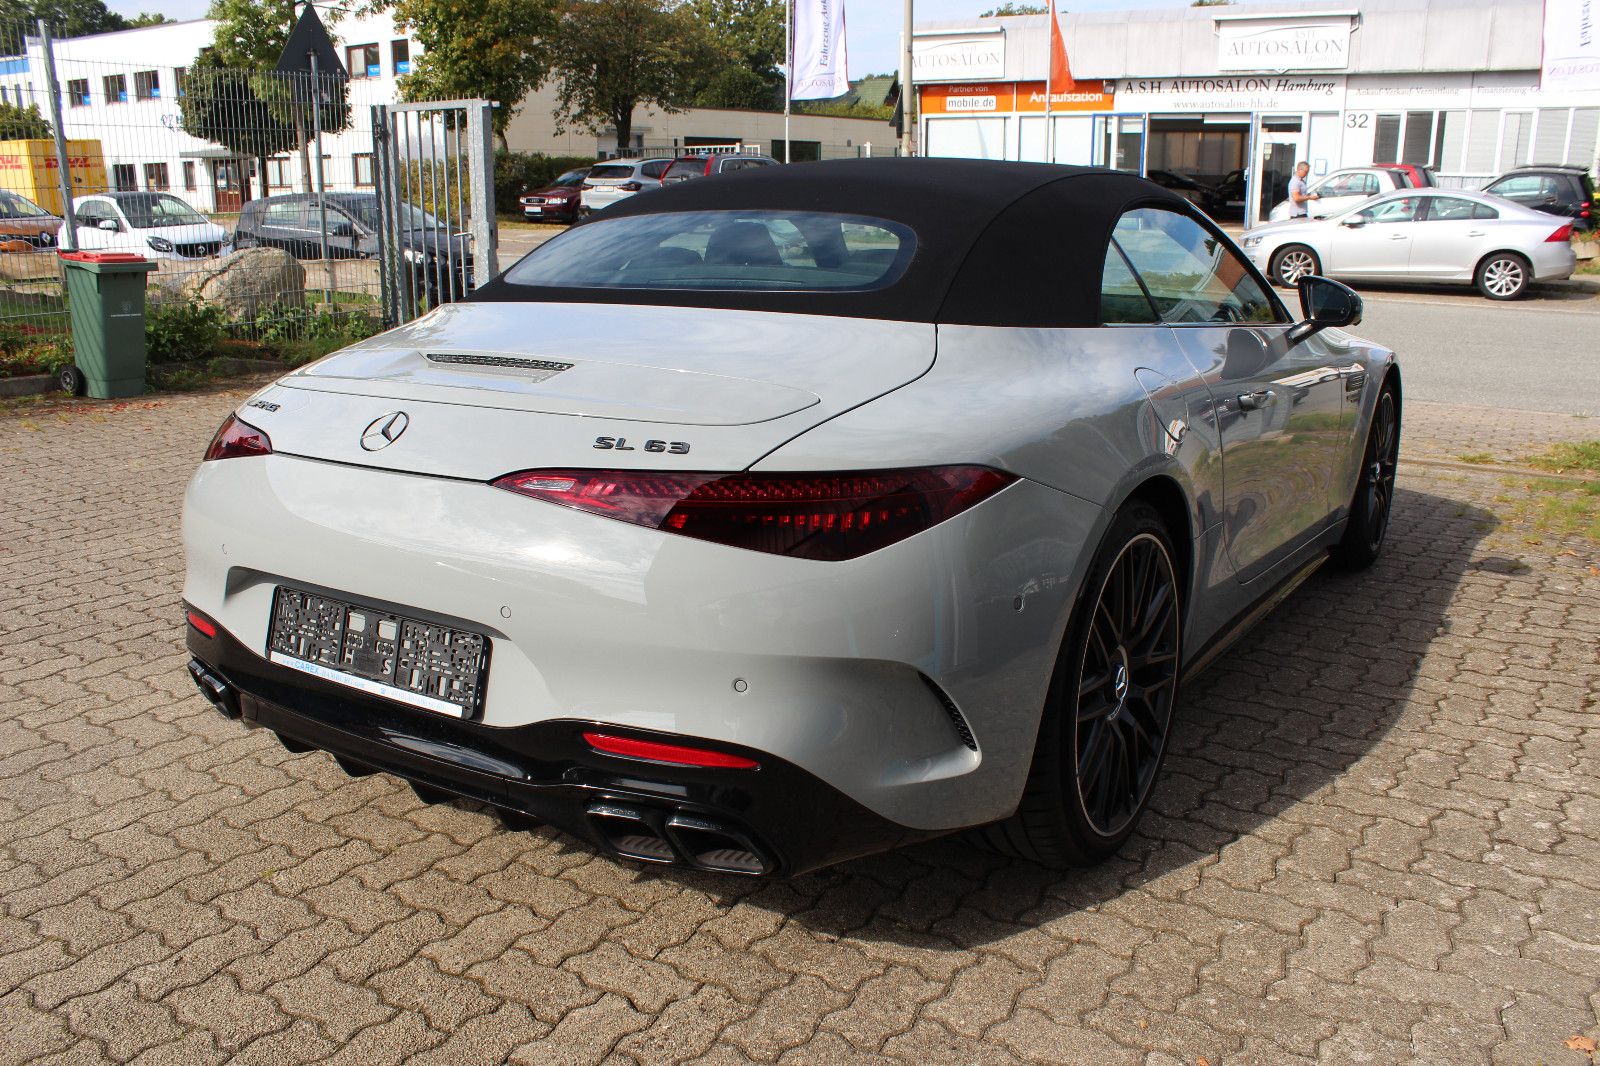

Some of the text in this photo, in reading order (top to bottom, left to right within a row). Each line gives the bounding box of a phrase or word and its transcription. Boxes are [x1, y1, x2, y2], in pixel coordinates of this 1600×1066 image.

[1226, 39, 1344, 56] AUTOSALON
[948, 84, 973, 93] Partner
[1124, 77, 1337, 96] A.S.H. AUTOSALON Hamburg
[947, 97, 994, 108] mobile.de
[1346, 113, 1369, 129] 32
[592, 436, 691, 455] SL 63
